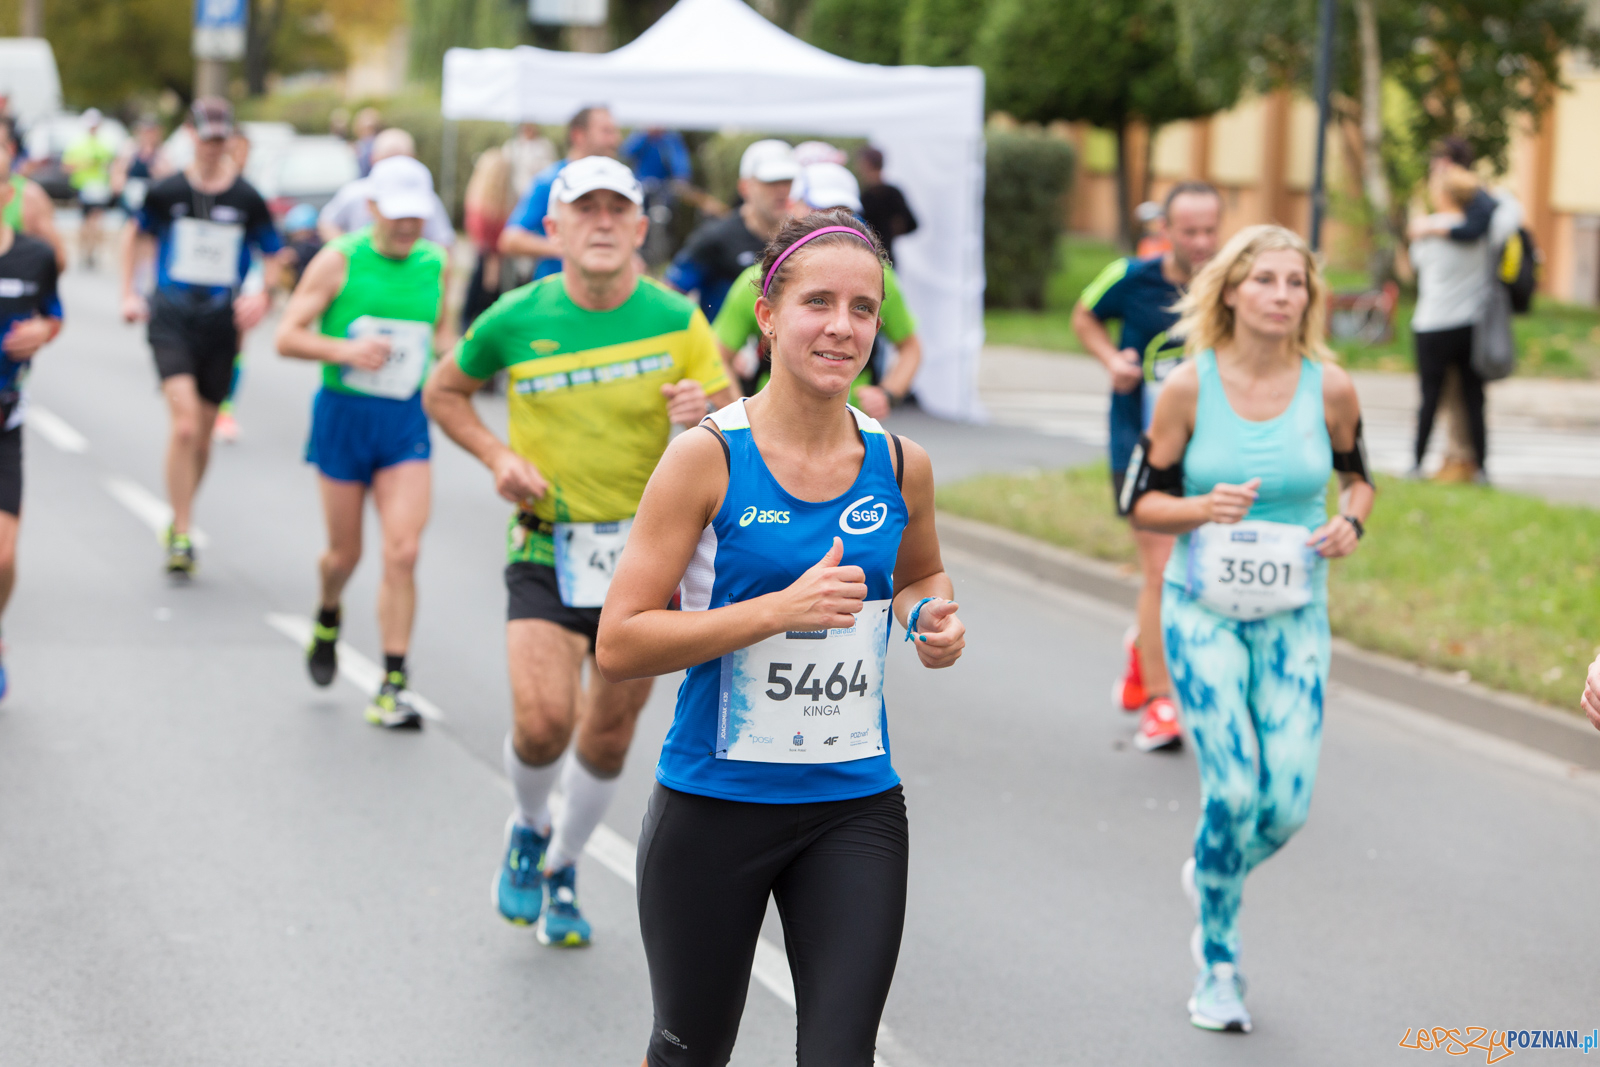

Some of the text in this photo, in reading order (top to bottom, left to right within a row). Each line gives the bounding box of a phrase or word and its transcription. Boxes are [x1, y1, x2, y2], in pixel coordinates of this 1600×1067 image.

[757, 510, 790, 524] asics
[851, 510, 879, 522] SGB
[1220, 557, 1292, 587] 3501
[830, 627, 857, 635] maraton
[765, 659, 868, 702] 5464
[803, 704, 841, 717] KINGA
[823, 736, 839, 746] 4F
